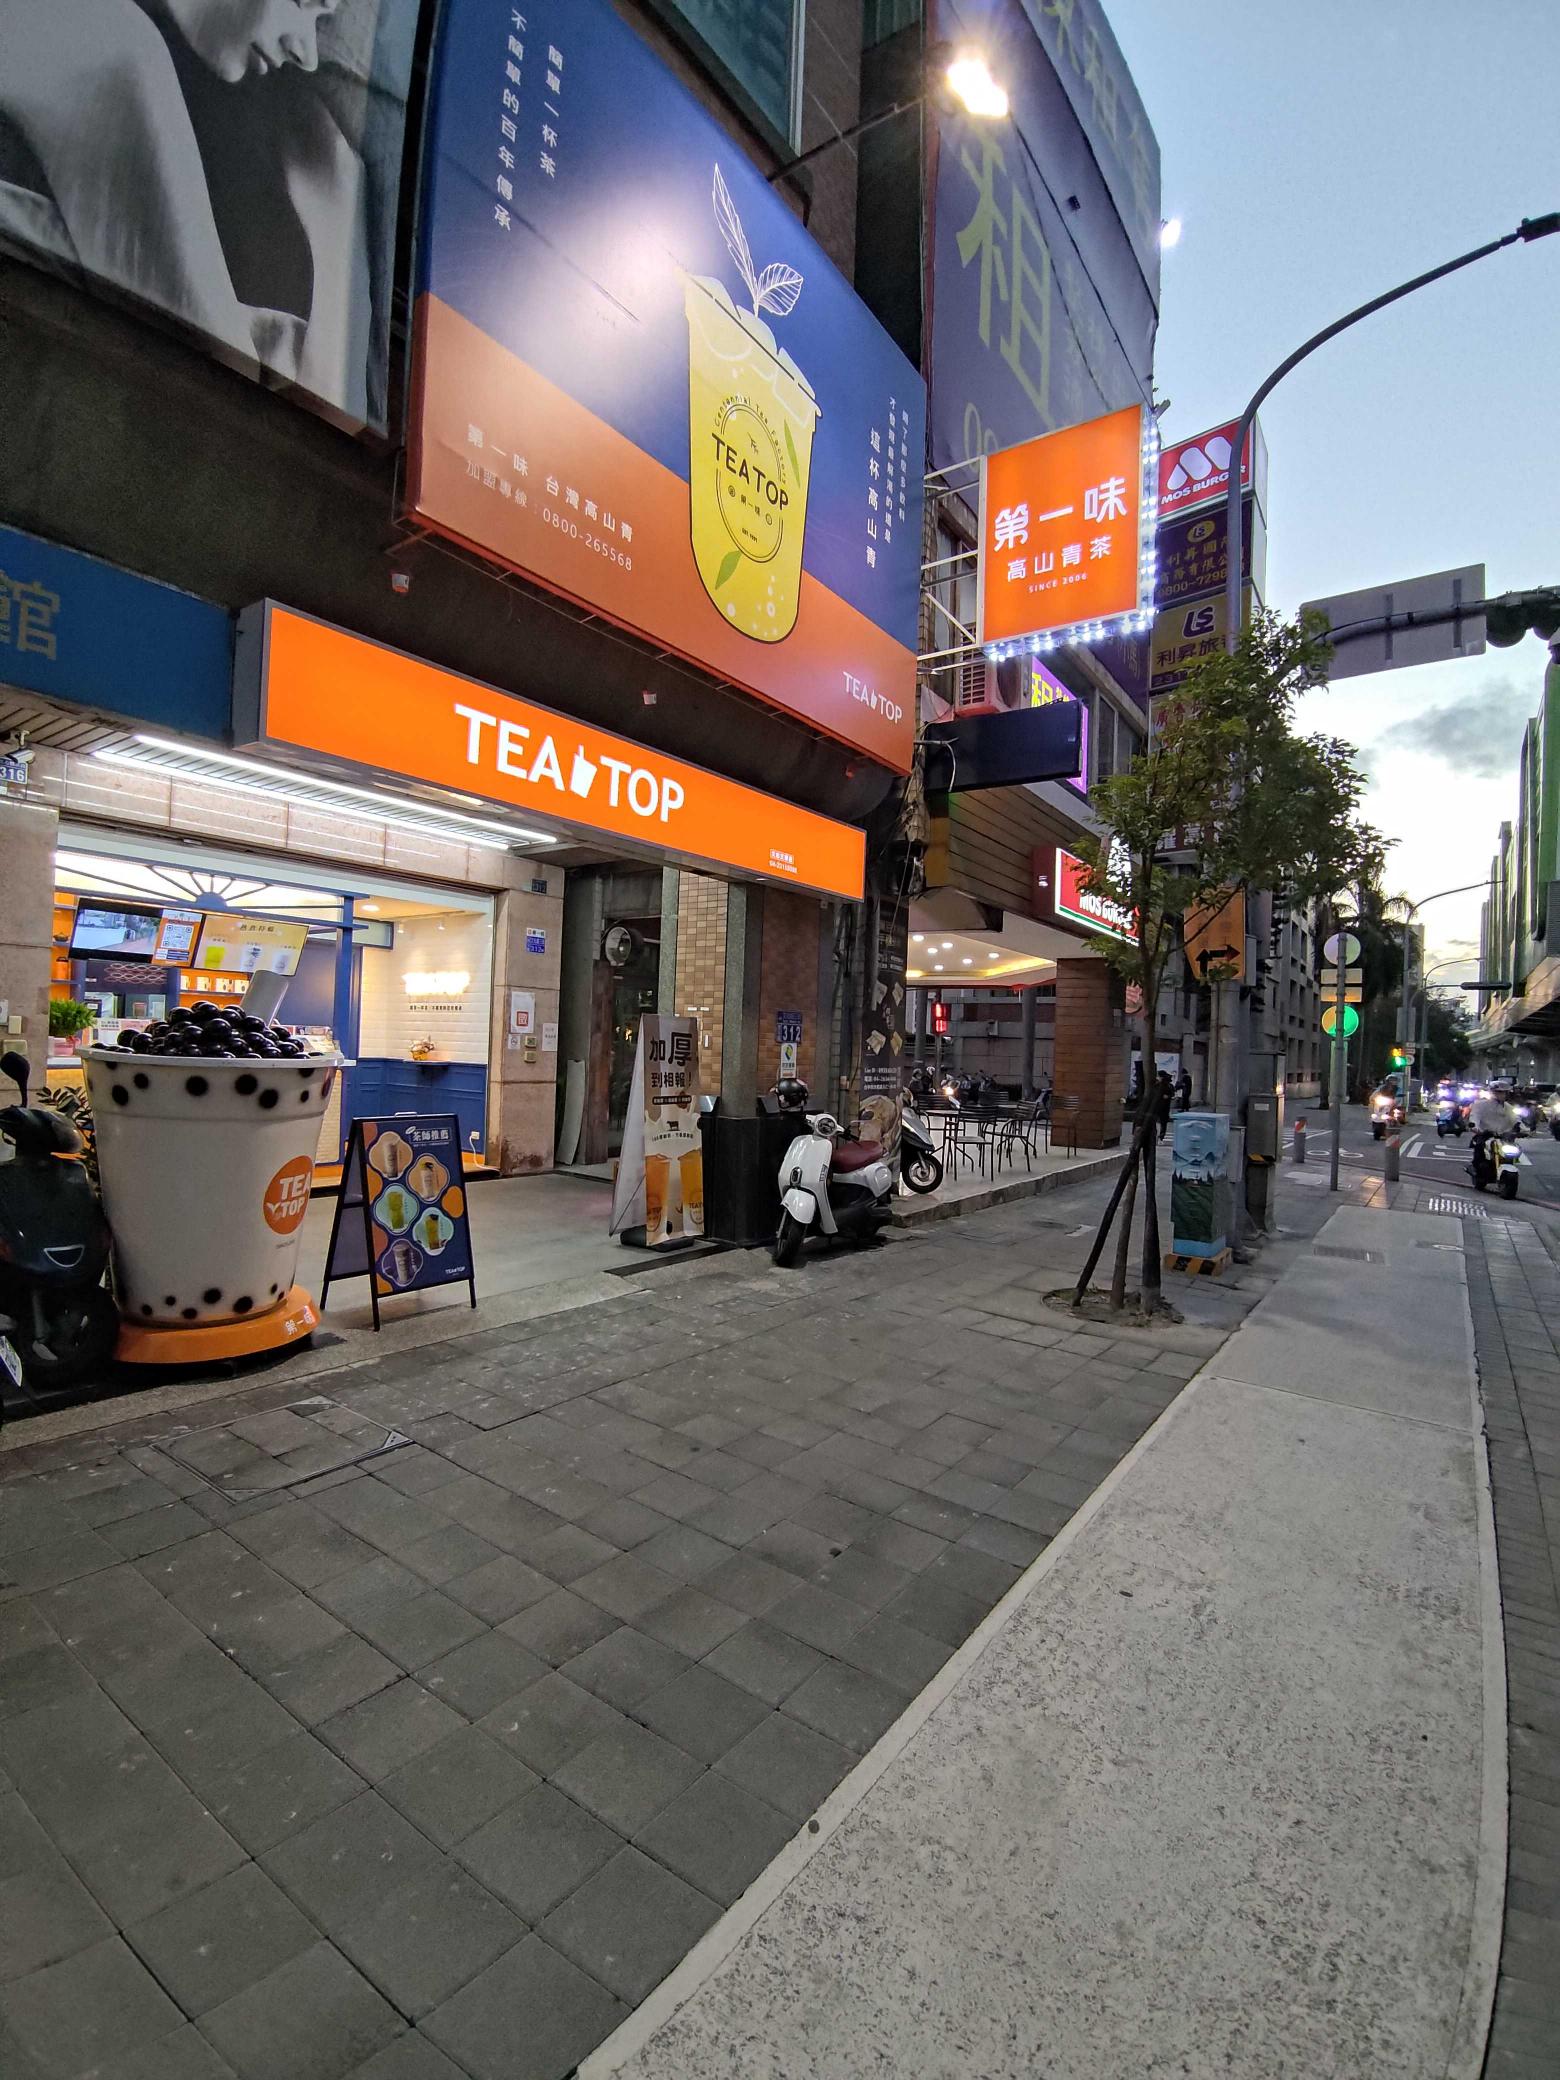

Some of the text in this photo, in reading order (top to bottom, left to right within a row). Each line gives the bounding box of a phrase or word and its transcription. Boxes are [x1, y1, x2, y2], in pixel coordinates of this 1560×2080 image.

[494, 8, 527, 231] 不簡單的百年傳承
[540, 45, 563, 178] 簡單一杯茶
[468, 423, 633, 543] 第一味 台灣高山青
[711, 432, 789, 511] TEATOP
[866, 427, 881, 569] 這杯高山青
[1161, 464, 1246, 505] MOS BURGR
[543, 507, 632, 571] 0800-265568
[993, 477, 1127, 552] 第一味
[1007, 535, 1112, 582] 高山青茶
[1029, 578, 1057, 593] SINCE
[843, 671, 903, 724] TEA TOP
[454, 703, 684, 823] TEA TOP
[649, 1031, 693, 1067] 加厚
[782, 1024, 801, 1041] 312
[280, 1171, 311, 1200] TEA
[281, 1197, 306, 1217] TOP
